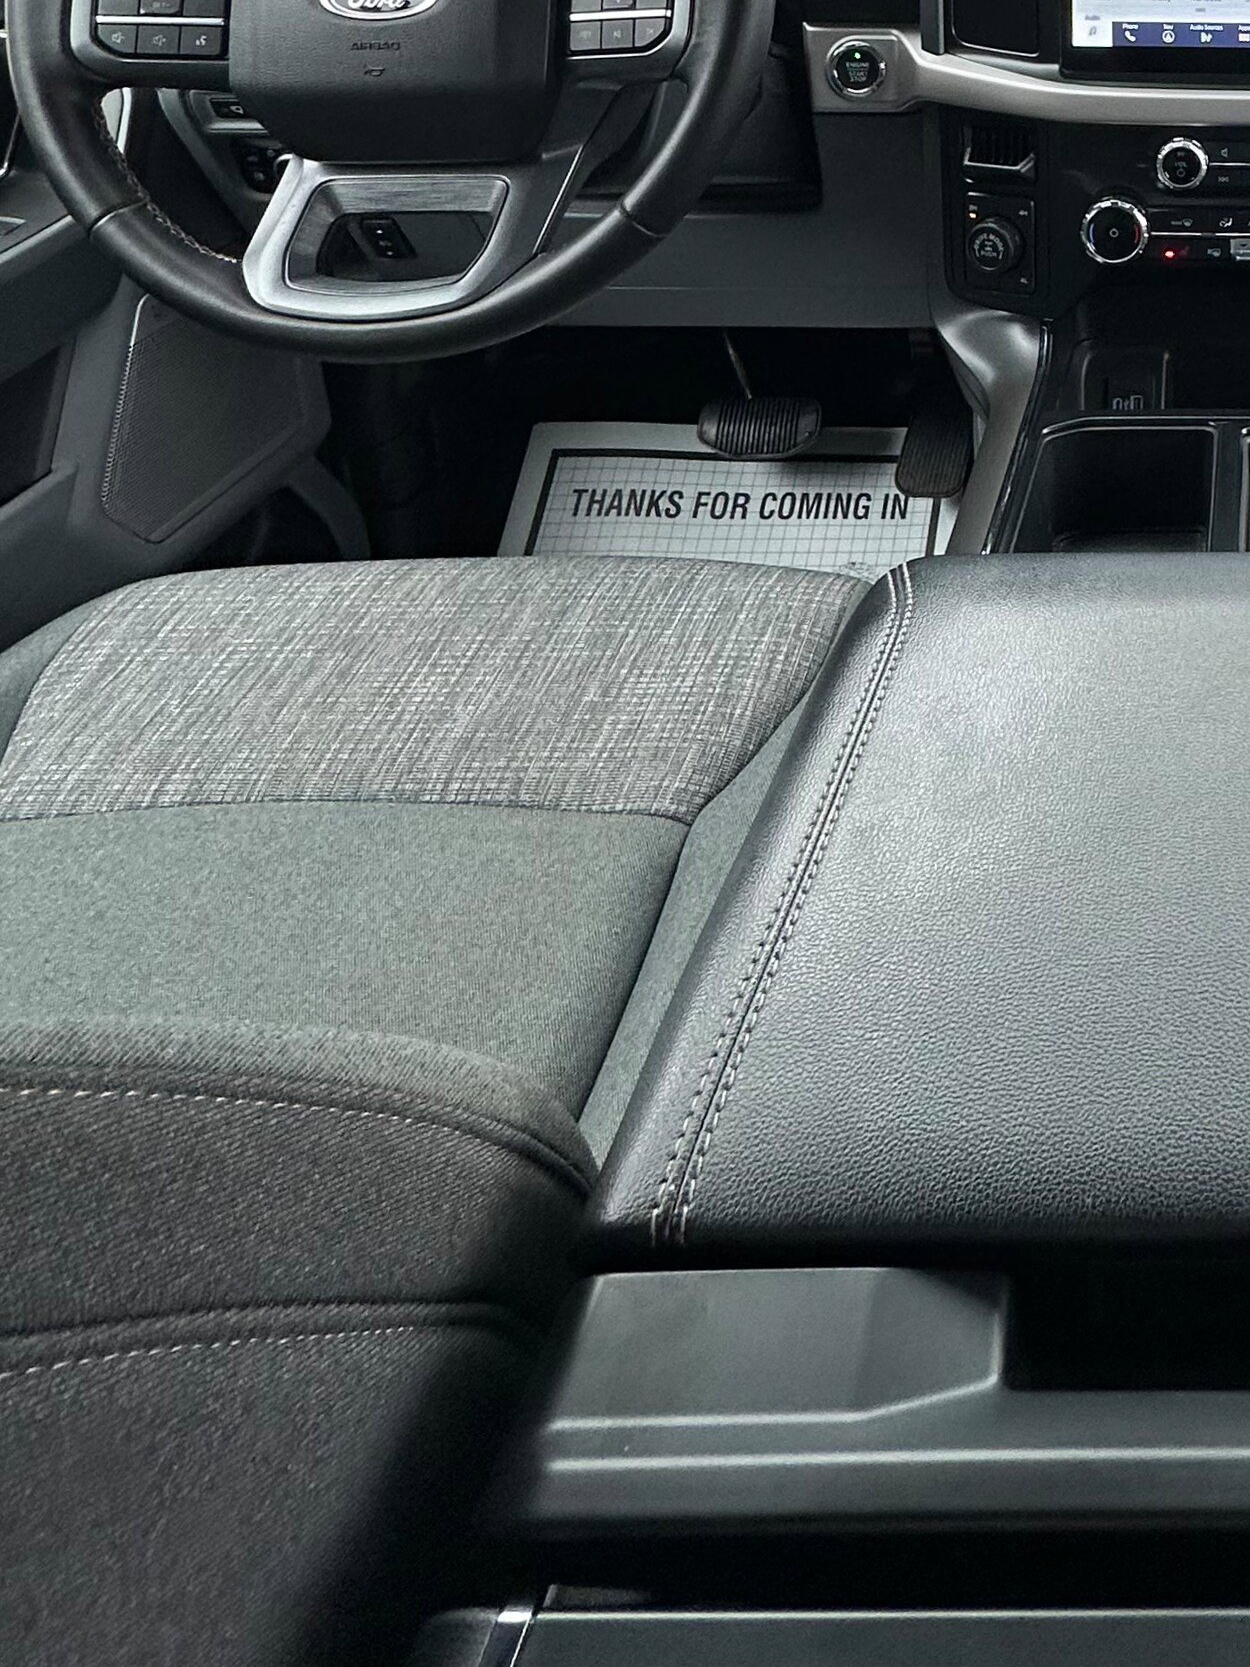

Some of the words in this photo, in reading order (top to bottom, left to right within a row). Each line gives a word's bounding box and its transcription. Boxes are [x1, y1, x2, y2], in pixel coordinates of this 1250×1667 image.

[571, 488, 684, 519] THANKS
[692, 490, 750, 520] FOR
[759, 492, 872, 521] COMING
[881, 494, 909, 521] IN
